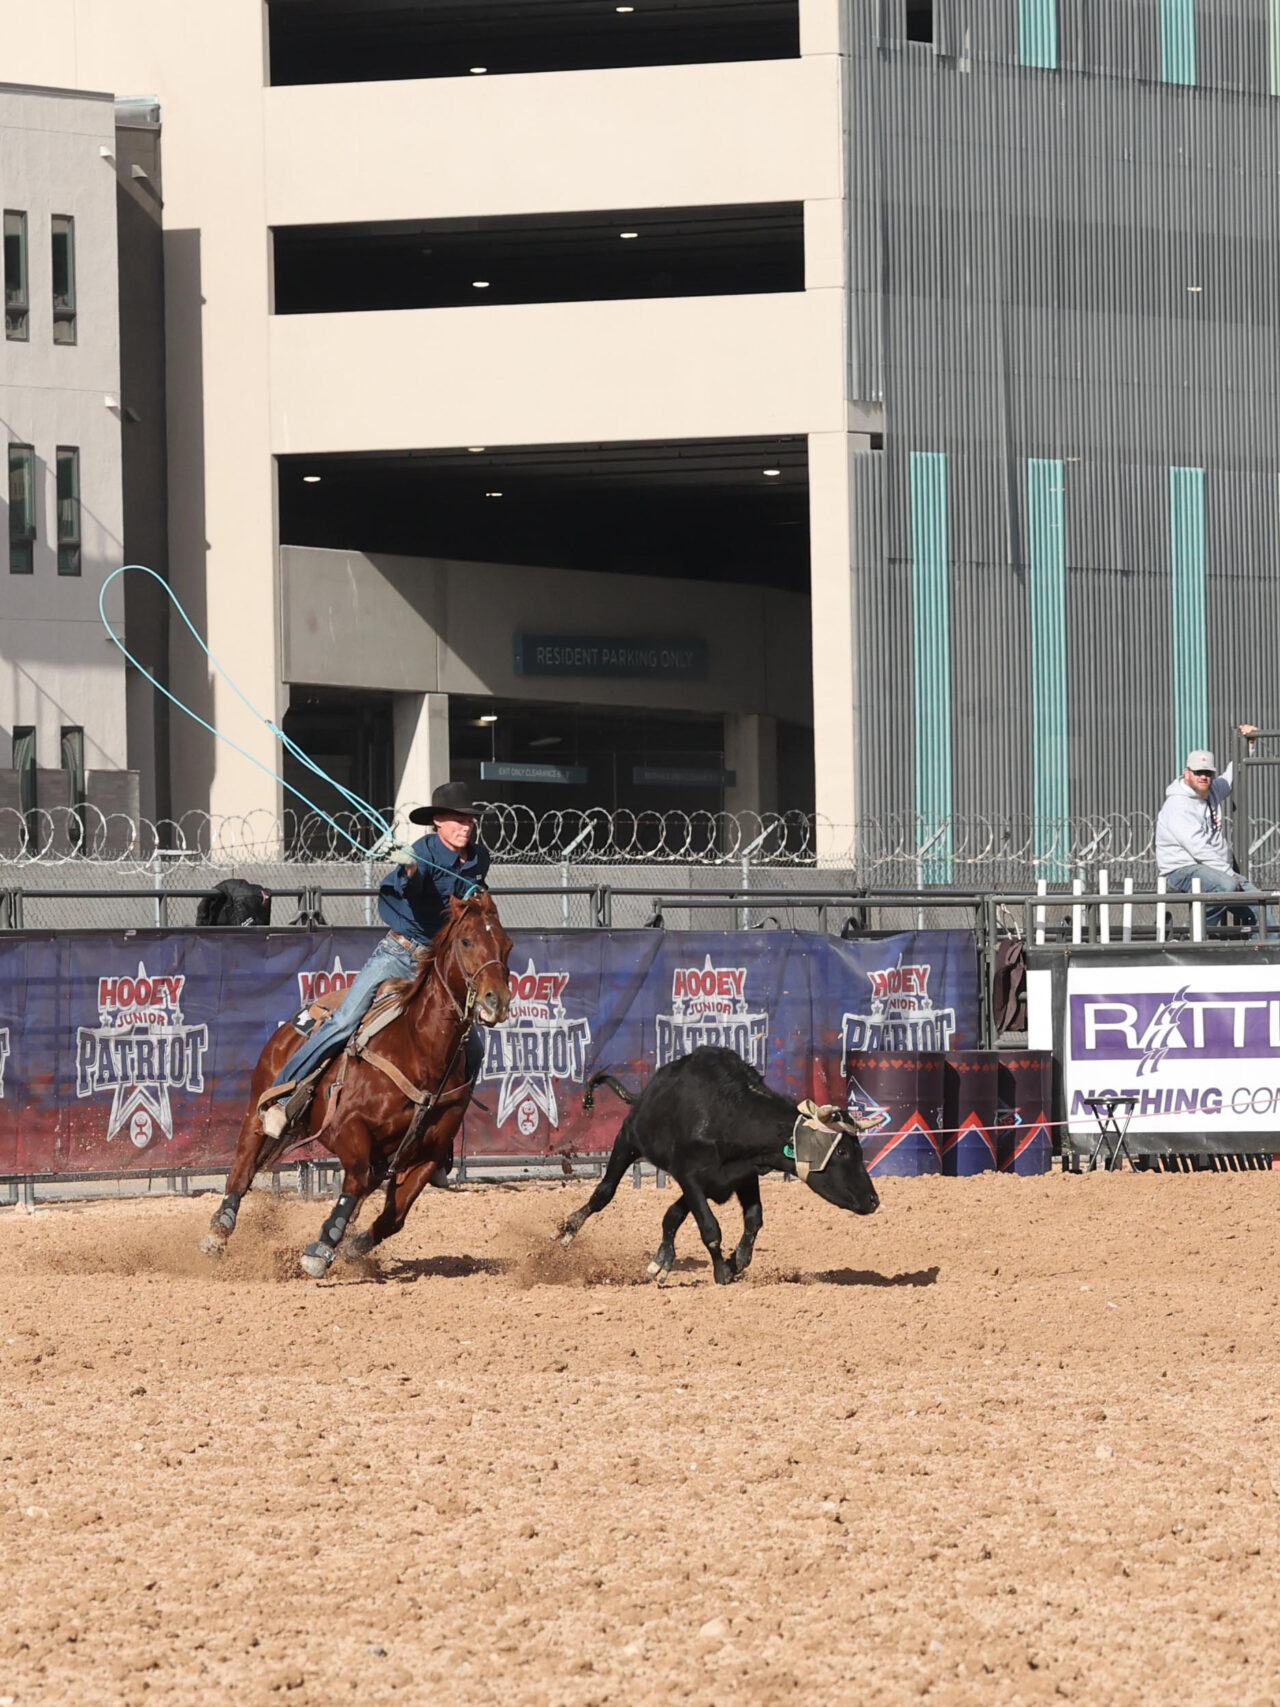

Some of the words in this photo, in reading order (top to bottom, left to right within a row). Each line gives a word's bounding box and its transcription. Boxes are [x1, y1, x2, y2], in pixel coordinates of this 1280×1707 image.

[536, 646, 598, 666] RESIDENT
[602, 648, 657, 667] PARKING
[659, 650, 694, 668] ONLY
[99, 976, 183, 1008] HOOEY
[299, 971, 360, 1002] HOO
[507, 972, 568, 1001] OOEY
[673, 969, 745, 998] HOOEY
[117, 1011, 166, 1027] JUNIOR
[509, 1005, 549, 1019] UNIOR
[688, 1002, 732, 1015] JUNIOR
[888, 1000, 916, 1012] NIOR
[482, 1019, 589, 1082] ATRIOT
[842, 1011, 955, 1066] PARIOT
[77, 1026, 207, 1096] PATRIOT
[1070, 1087, 1223, 1116] NOTHING
